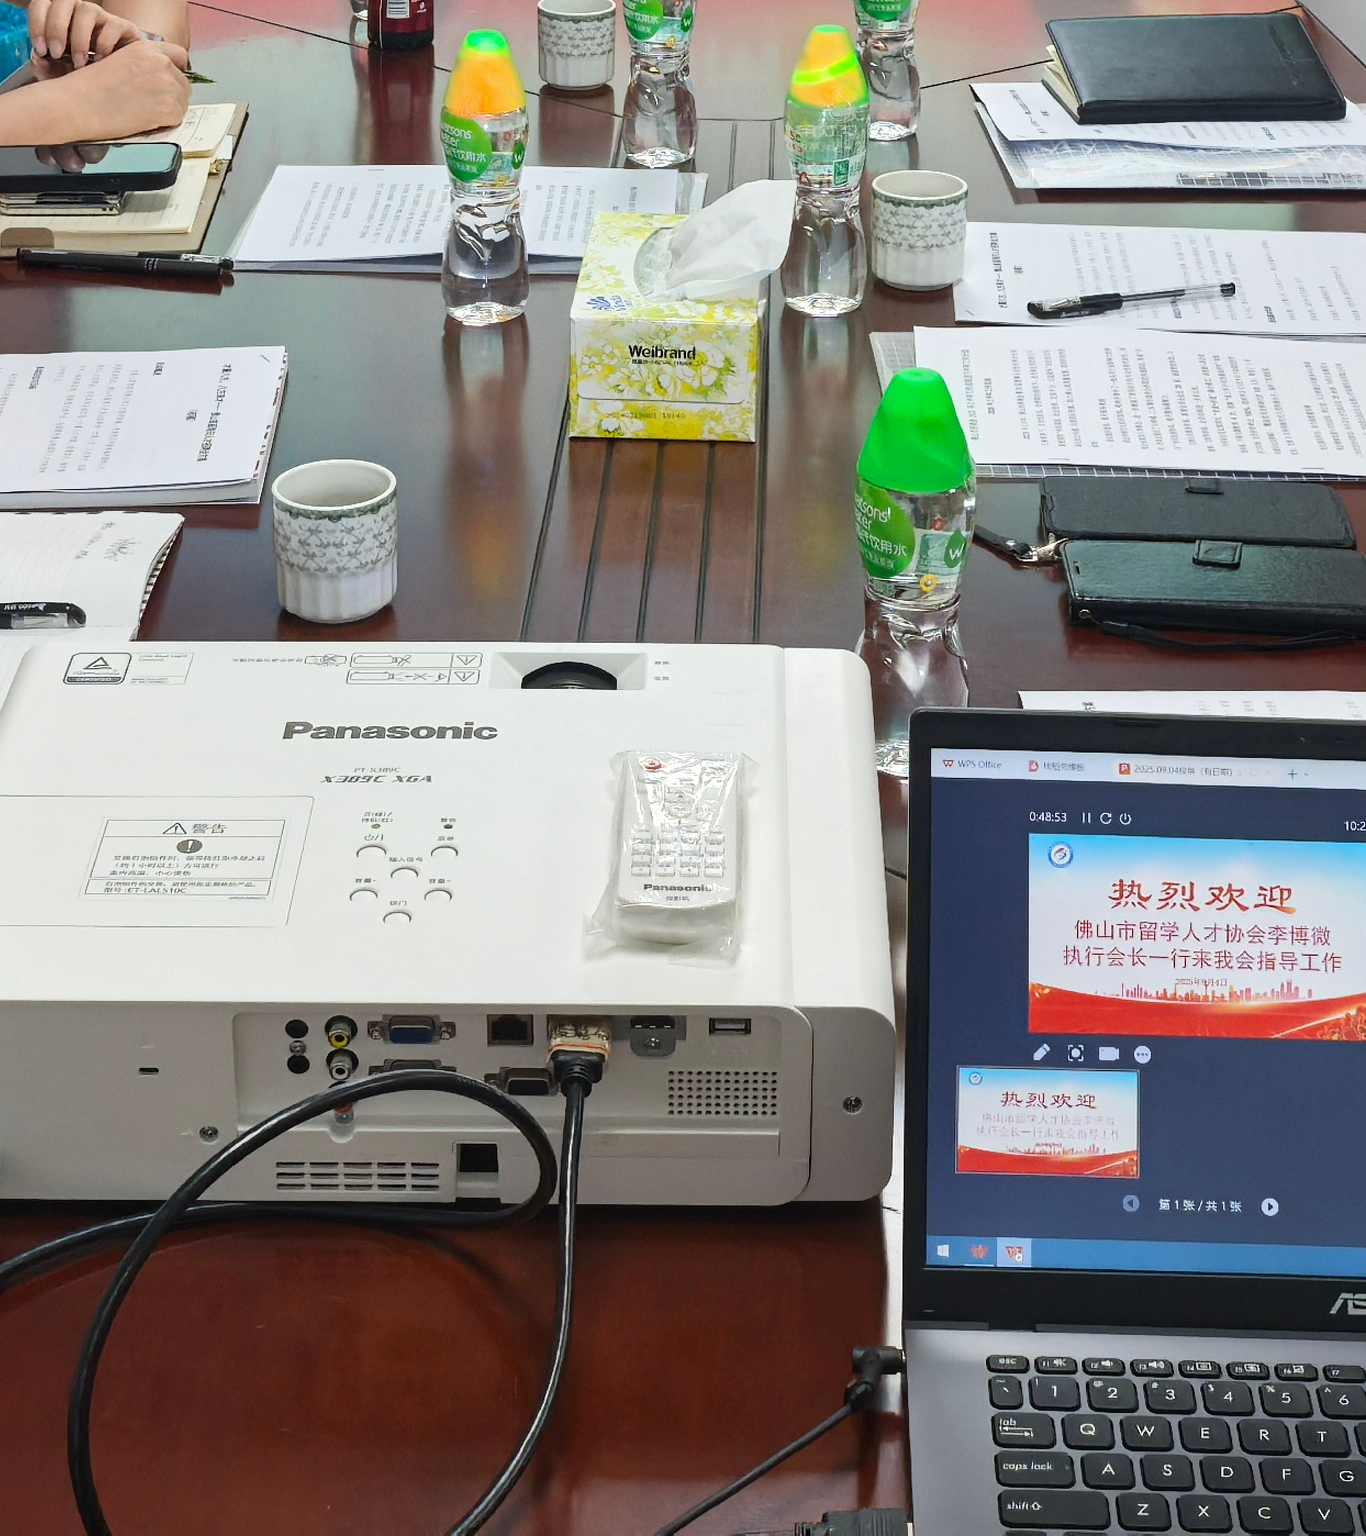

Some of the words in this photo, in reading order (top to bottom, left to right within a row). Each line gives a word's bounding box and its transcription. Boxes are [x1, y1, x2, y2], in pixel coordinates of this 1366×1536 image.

[628, 345, 697, 360] Weibrand
[282, 721, 499, 742] Panasonic
[957, 758, 976, 769] WPS
[391, 775, 433, 784] XGA
[1029, 810, 1068, 824] 0:48:53
[1107, 877, 1299, 915] 热烈欢迎
[1073, 919, 1332, 947] 佛山市留学人才协会李博微
[1062, 945, 1344, 974] 执行会长一行来我会指导工作
[999, 1090, 1098, 1111] 热烈欢迎
